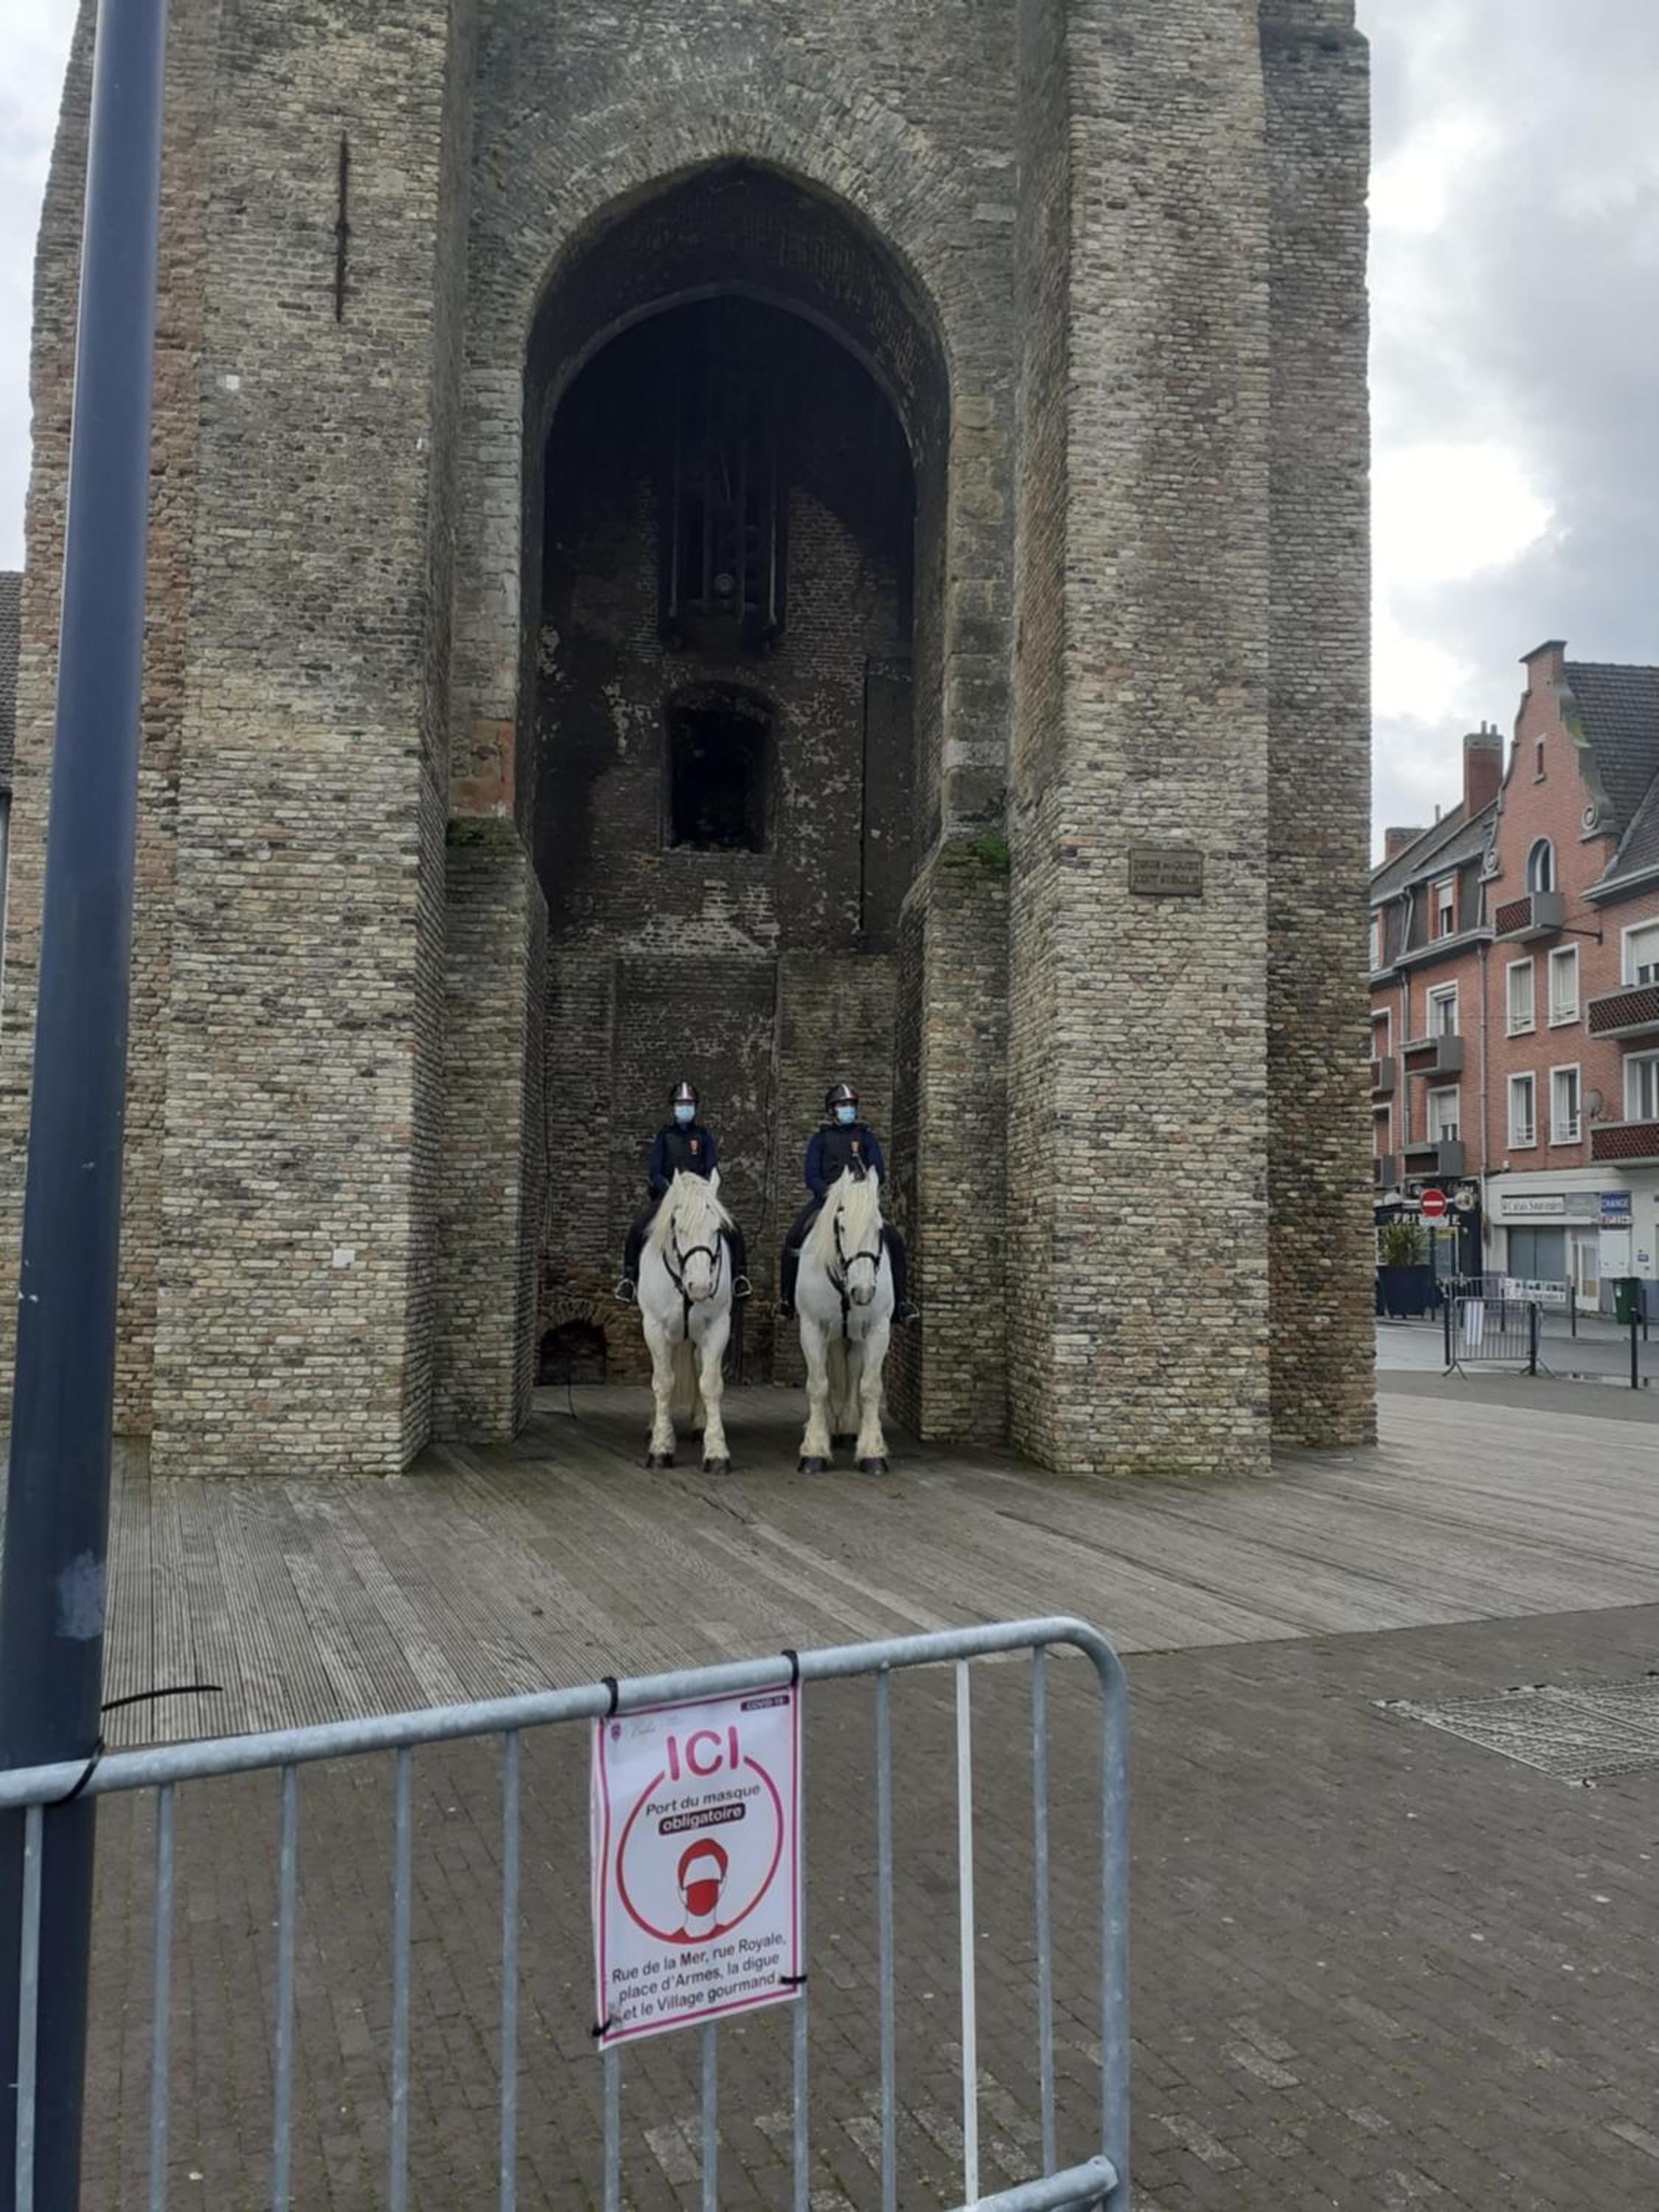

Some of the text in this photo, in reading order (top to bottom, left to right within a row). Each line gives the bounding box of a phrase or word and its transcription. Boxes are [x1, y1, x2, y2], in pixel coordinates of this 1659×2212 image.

[667, 1725, 739, 1781] ICI
[646, 1784, 761, 1816] Port du masque
[663, 1806, 742, 1832] obligatoire
[612, 1932, 787, 1984] Rue de la Mer, rue Royale,
[619, 1981, 658, 2006] place
[726, 1961, 739, 1976] la
[742, 1953, 780, 1973] digue
[623, 1970, 776, 2020] et le Village gourmand
